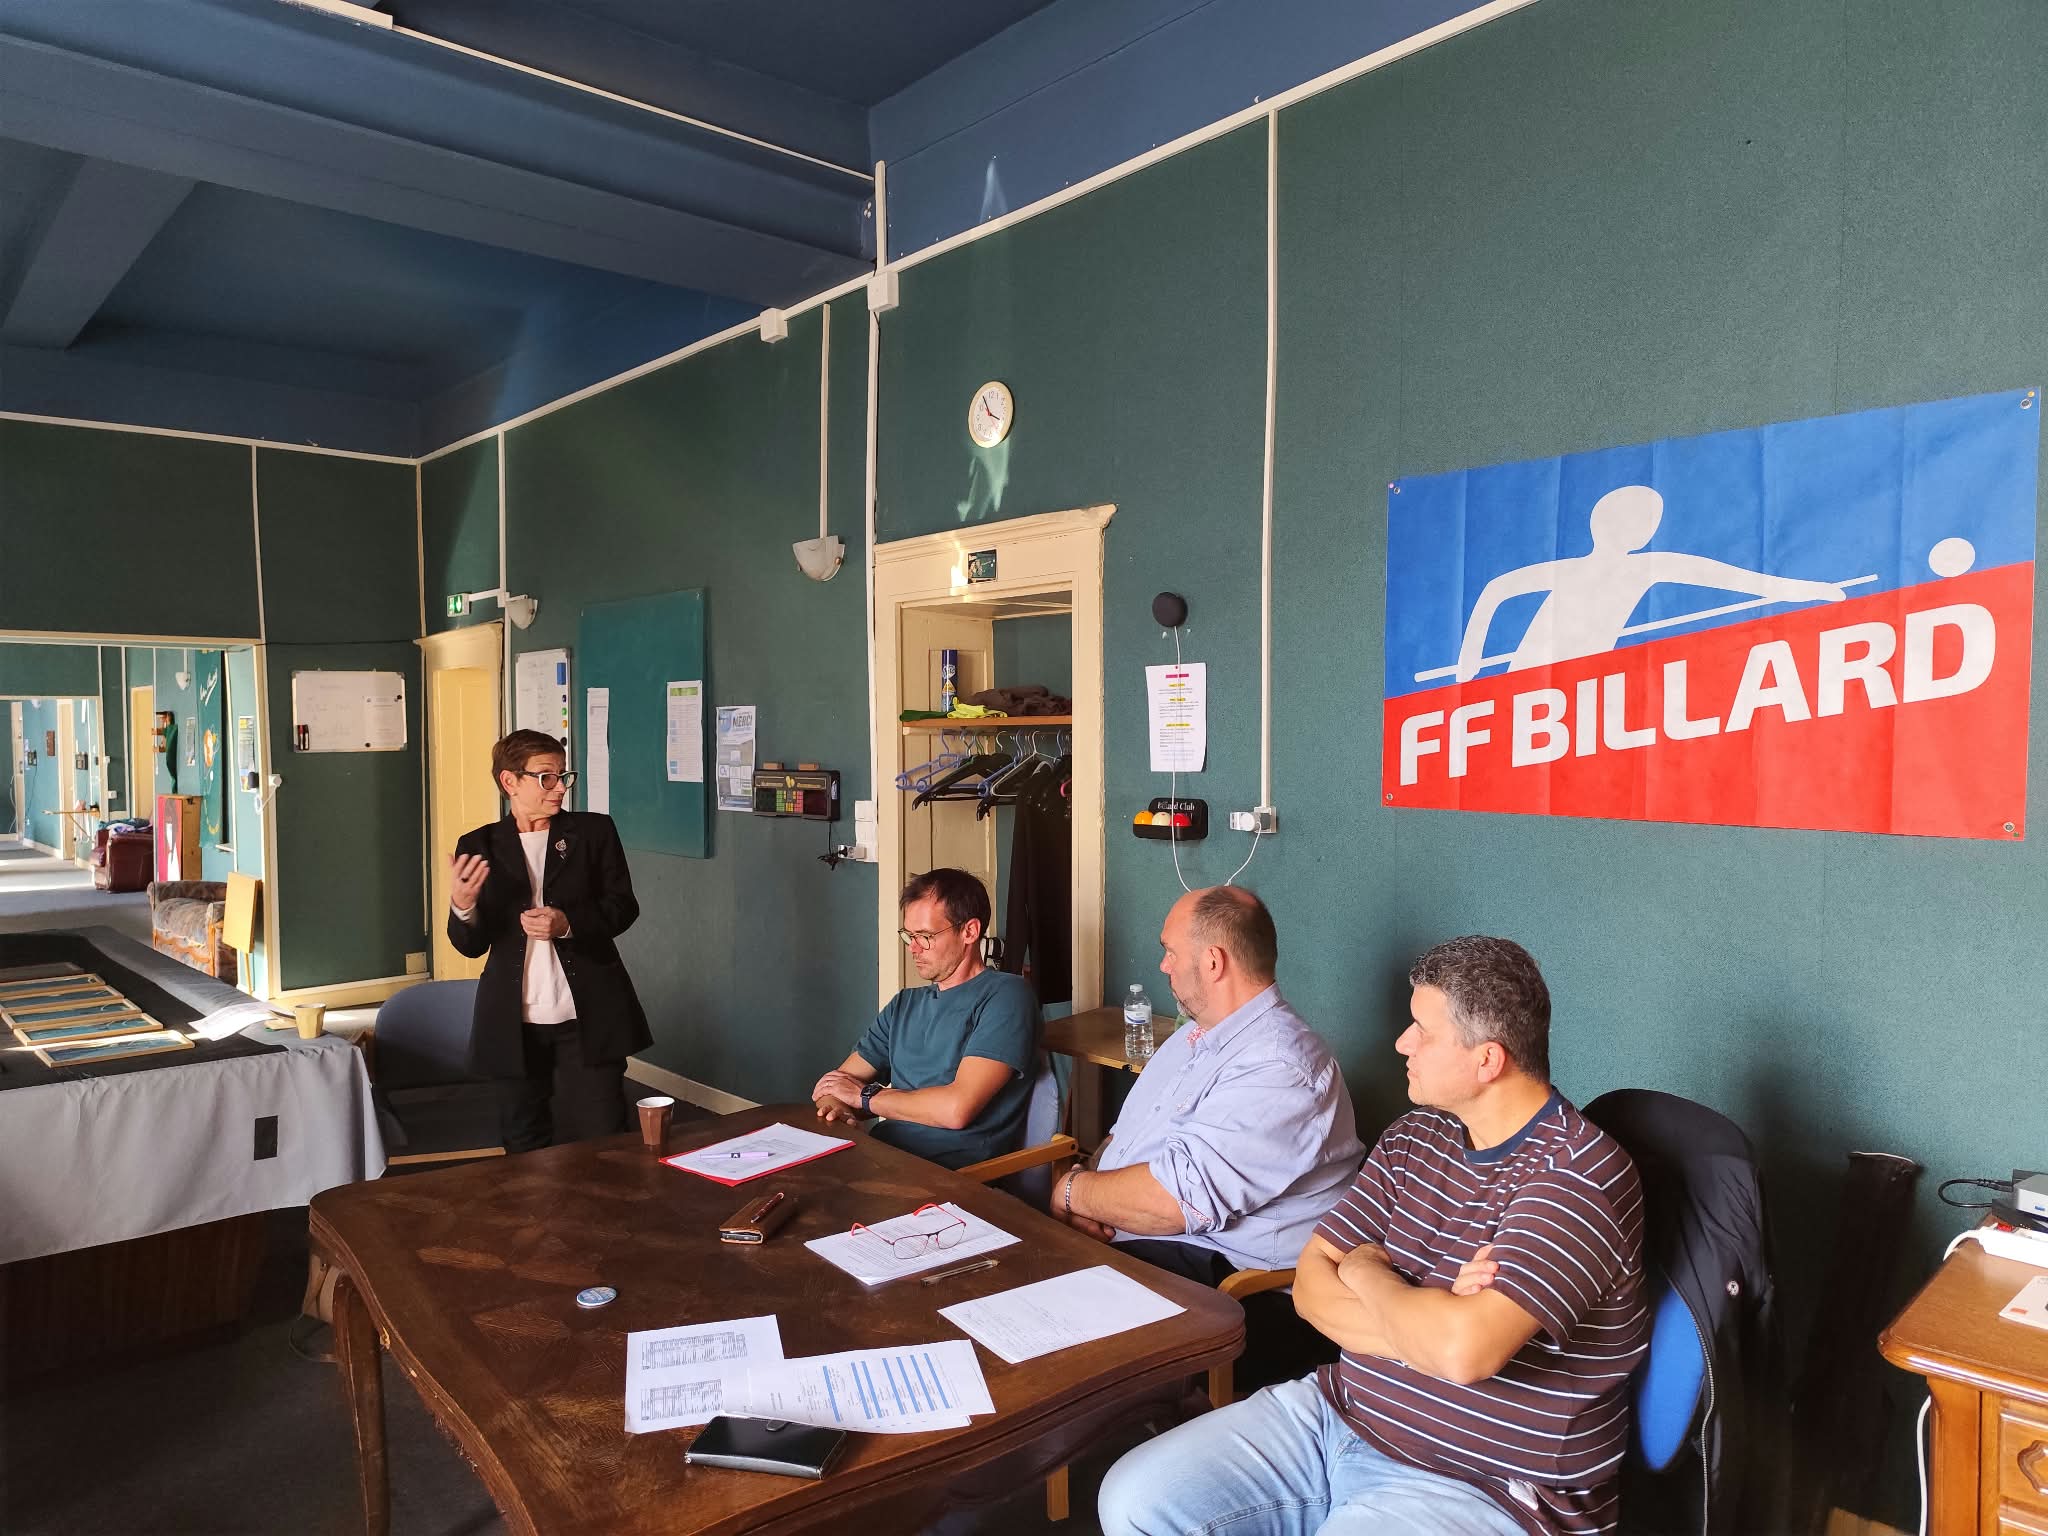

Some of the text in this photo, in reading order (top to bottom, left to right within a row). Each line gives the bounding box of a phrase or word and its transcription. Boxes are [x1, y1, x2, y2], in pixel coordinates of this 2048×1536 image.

[1400, 603, 1997, 786] FF BILLARD
[1179, 802, 1195, 811] Club
